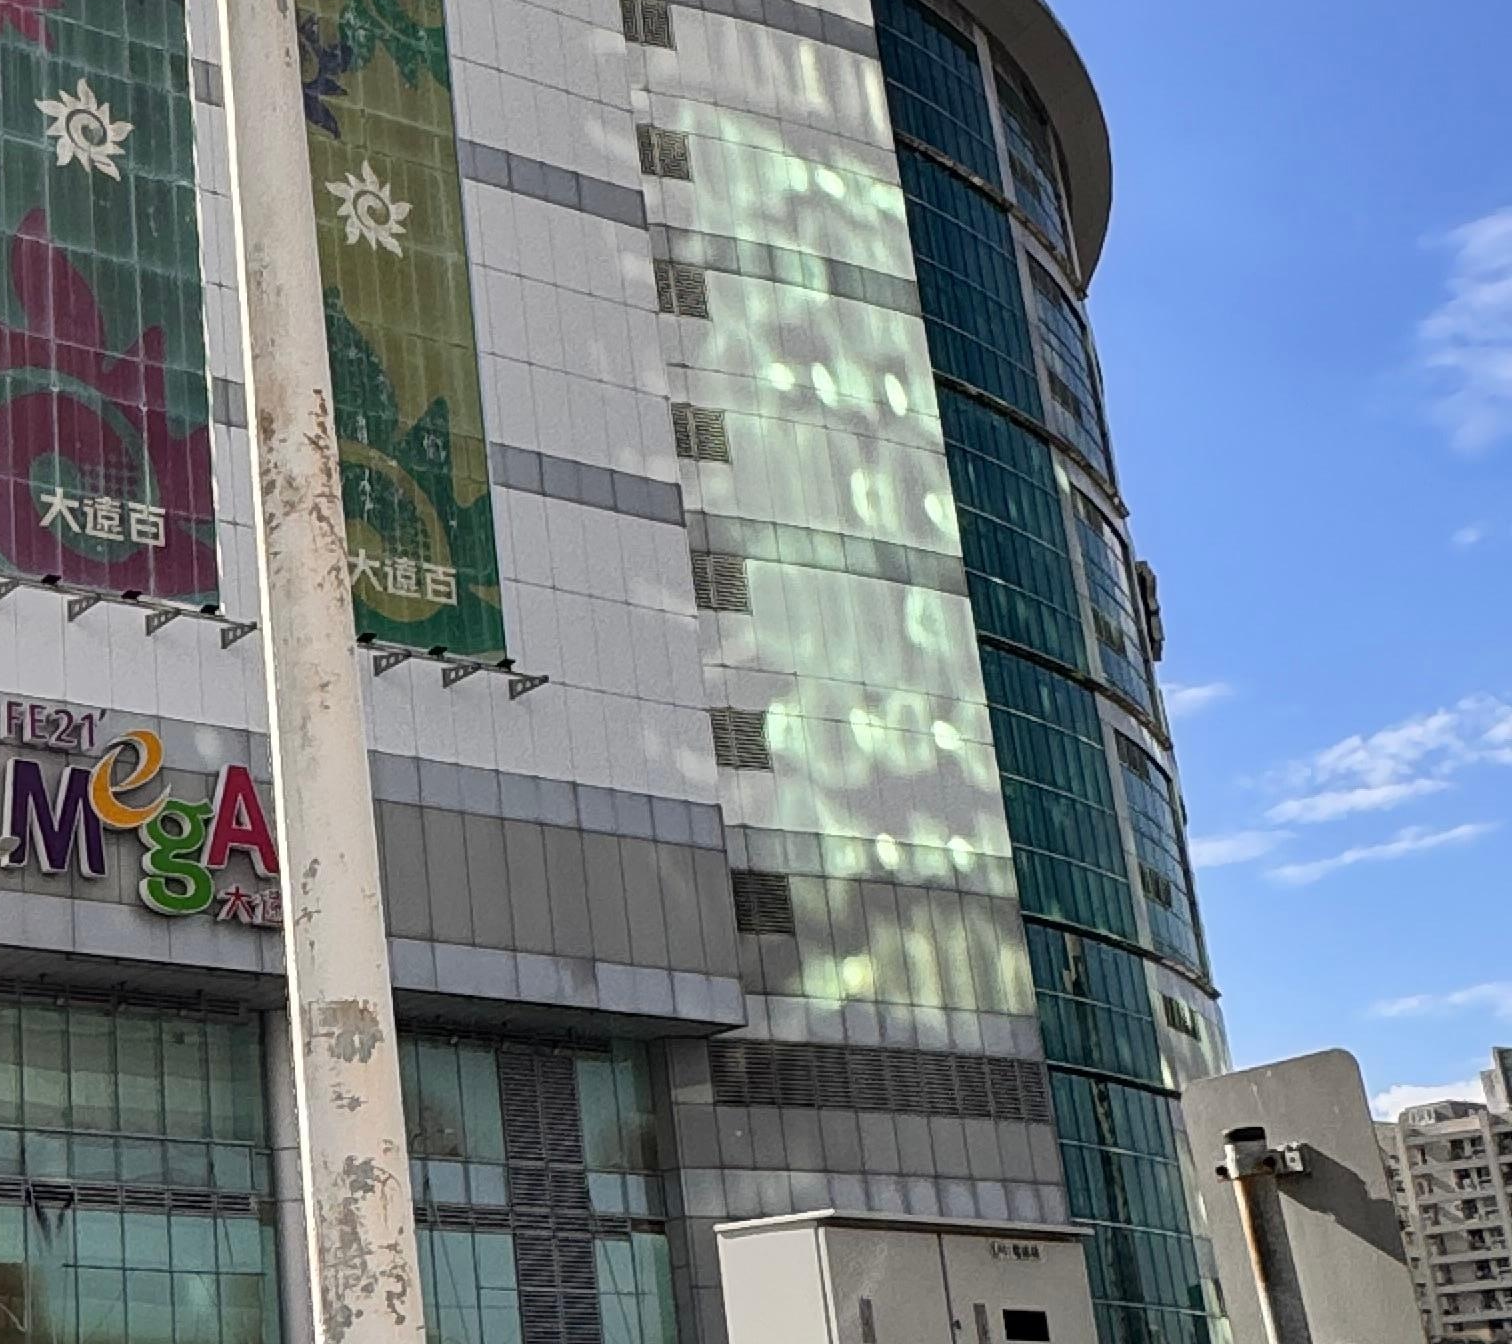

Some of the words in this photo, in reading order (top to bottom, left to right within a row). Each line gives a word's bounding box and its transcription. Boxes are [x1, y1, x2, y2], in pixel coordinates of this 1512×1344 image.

[39, 486, 166, 548] 大遠百
[347, 548, 458, 606] 大遠百
